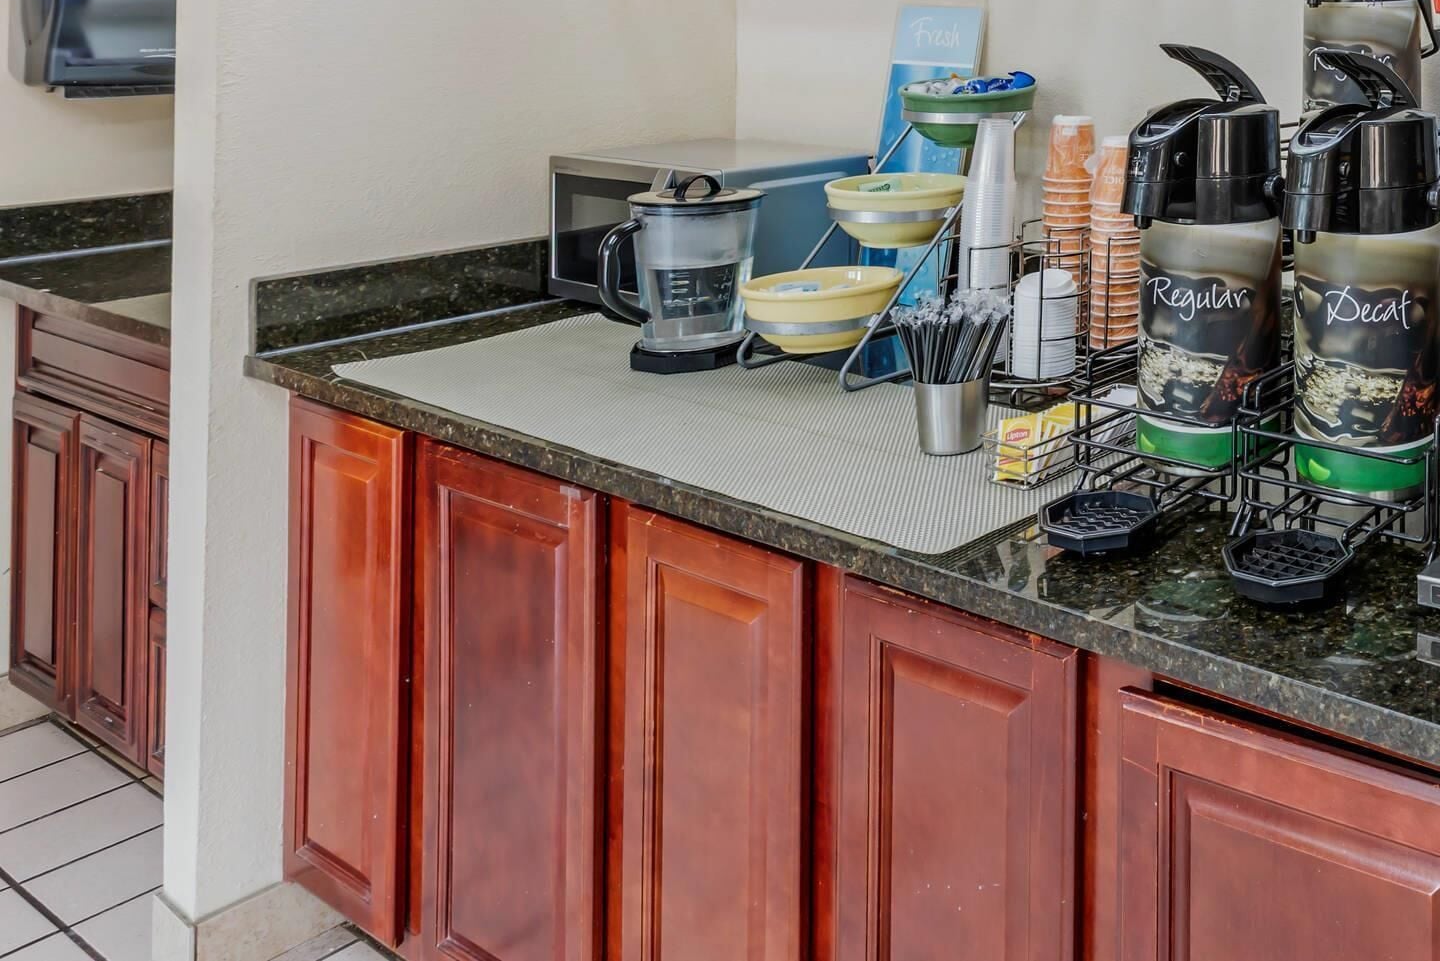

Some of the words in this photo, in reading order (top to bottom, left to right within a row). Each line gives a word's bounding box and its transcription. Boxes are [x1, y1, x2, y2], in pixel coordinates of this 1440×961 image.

[910, 16, 960, 48] Fresh
[1146, 276, 1250, 321] Regular
[1325, 285, 1411, 330] Decaf
[1006, 430, 1028, 441] Lipton
